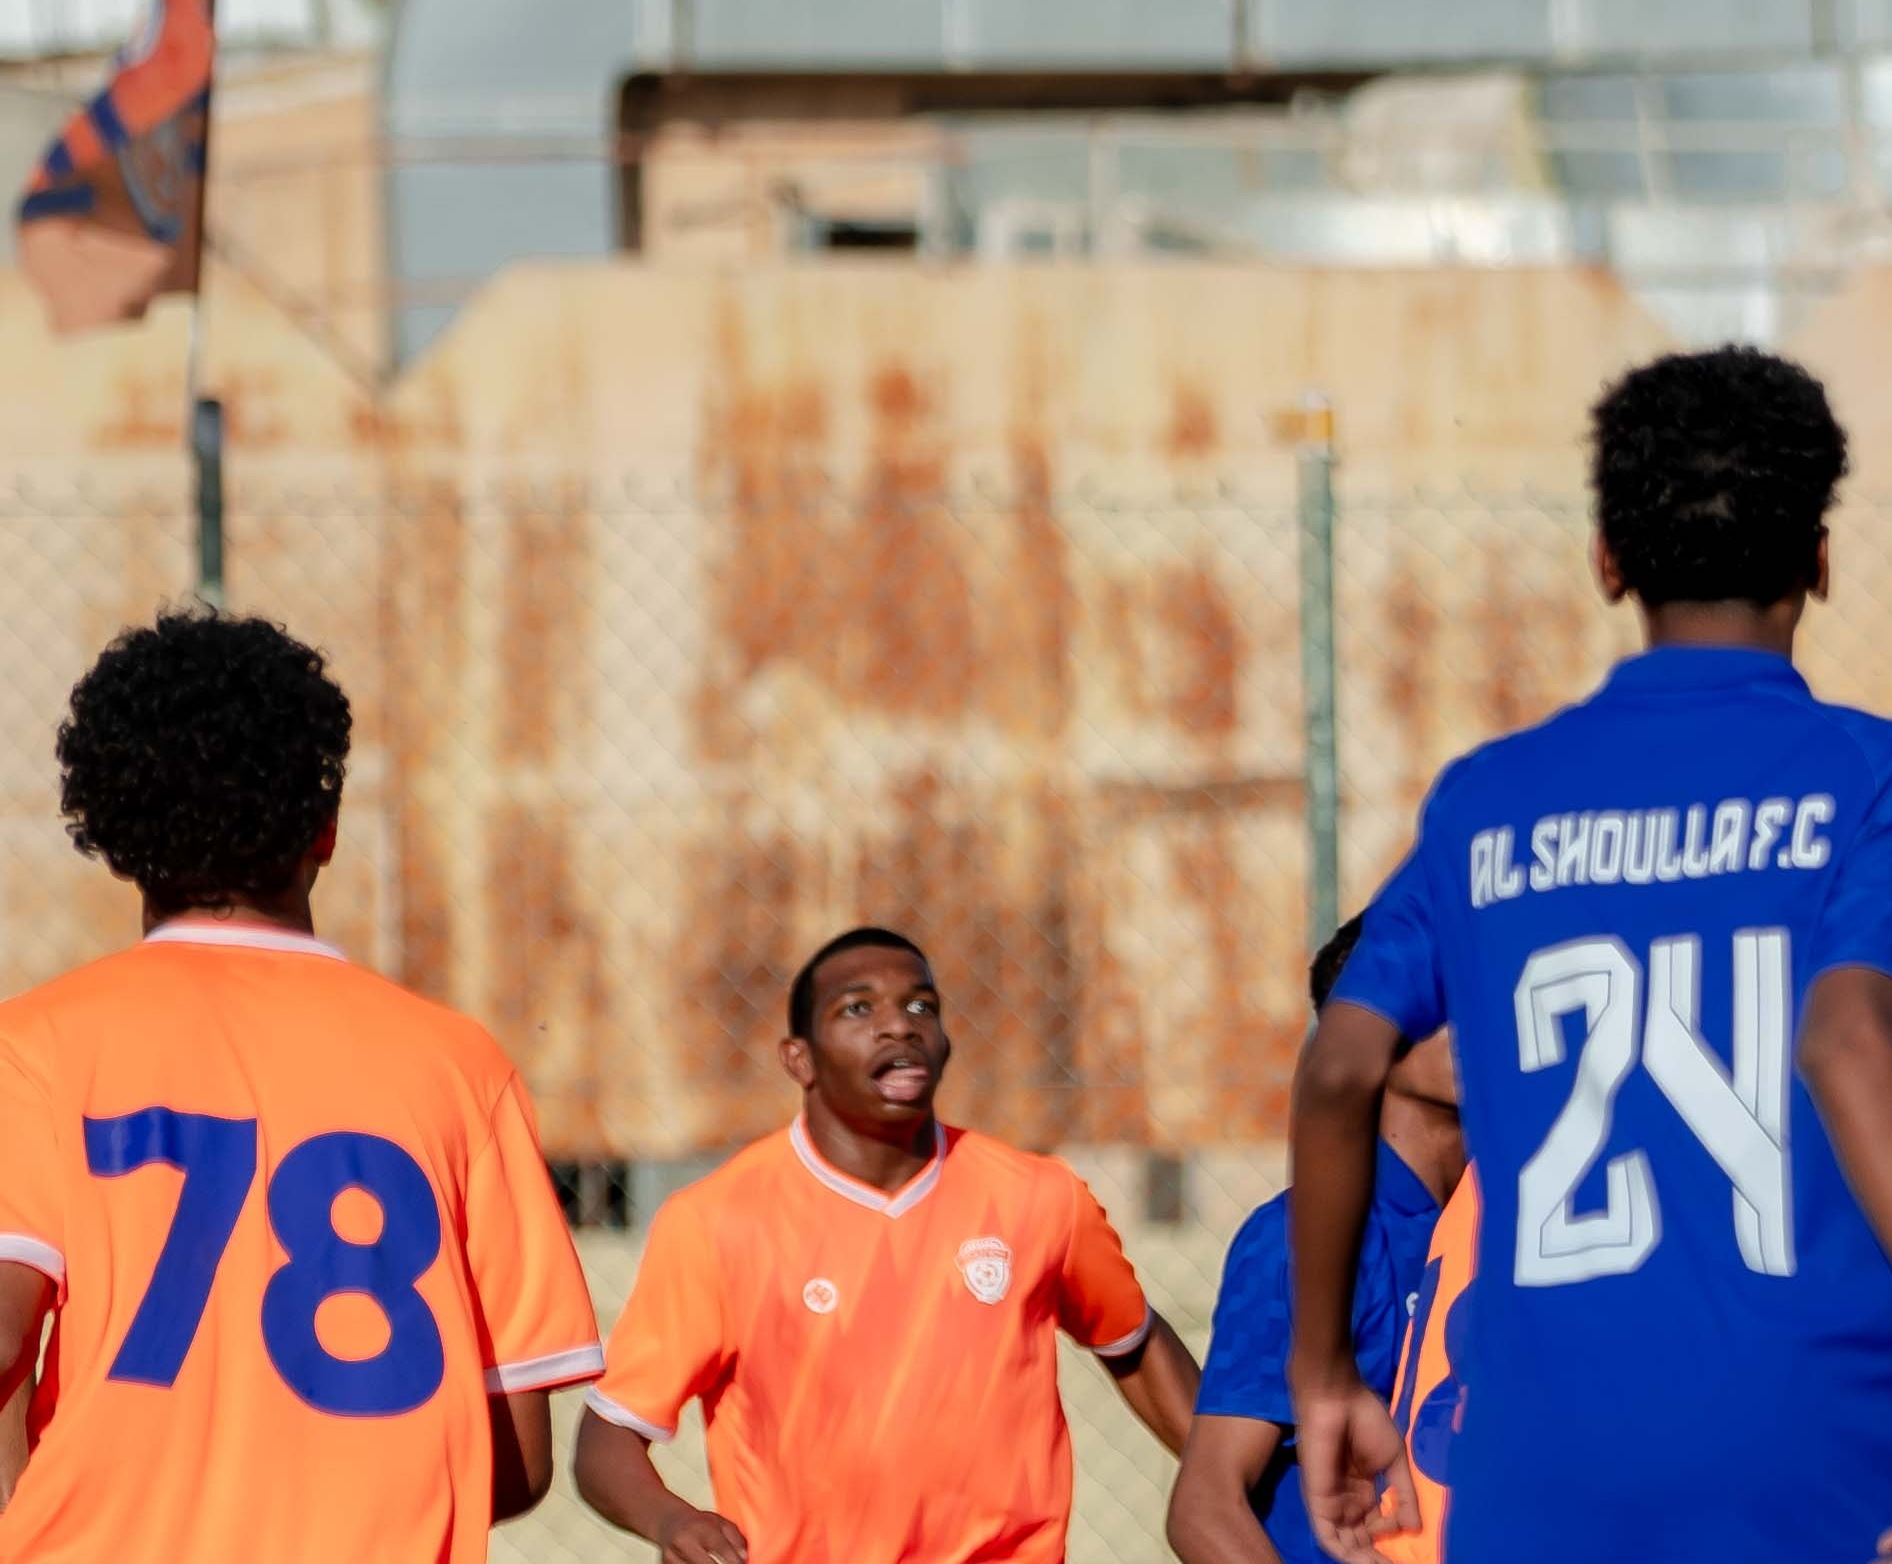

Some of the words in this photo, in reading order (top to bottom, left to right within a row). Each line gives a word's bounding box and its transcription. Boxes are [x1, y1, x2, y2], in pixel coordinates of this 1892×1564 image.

[1470, 826, 1525, 908] AL
[81, 1104, 447, 1418] 78
[1513, 927, 1796, 1287] 24
